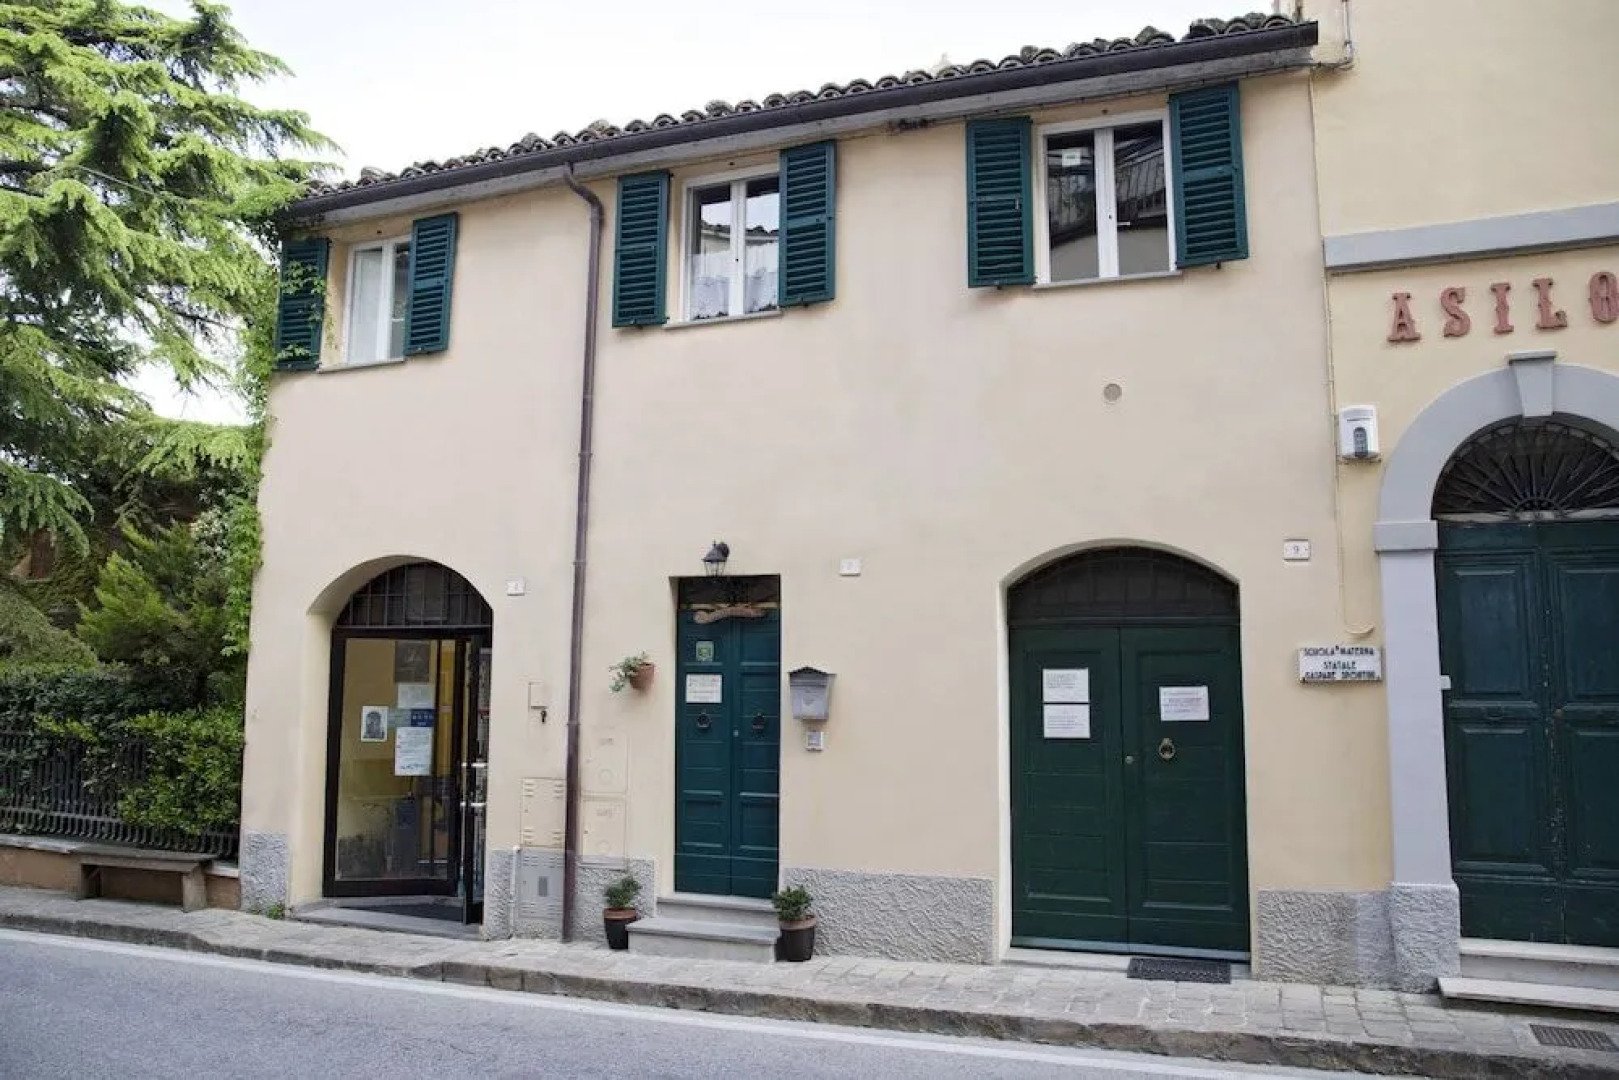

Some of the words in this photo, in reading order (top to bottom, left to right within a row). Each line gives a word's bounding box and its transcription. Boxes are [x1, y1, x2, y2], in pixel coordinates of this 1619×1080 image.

[1387, 271, 1619, 343] ASILO
[1305, 648, 1334, 656] SCUOLA
[1340, 647, 1374, 655] MATERNA
[1323, 661, 1357, 669] STATALE
